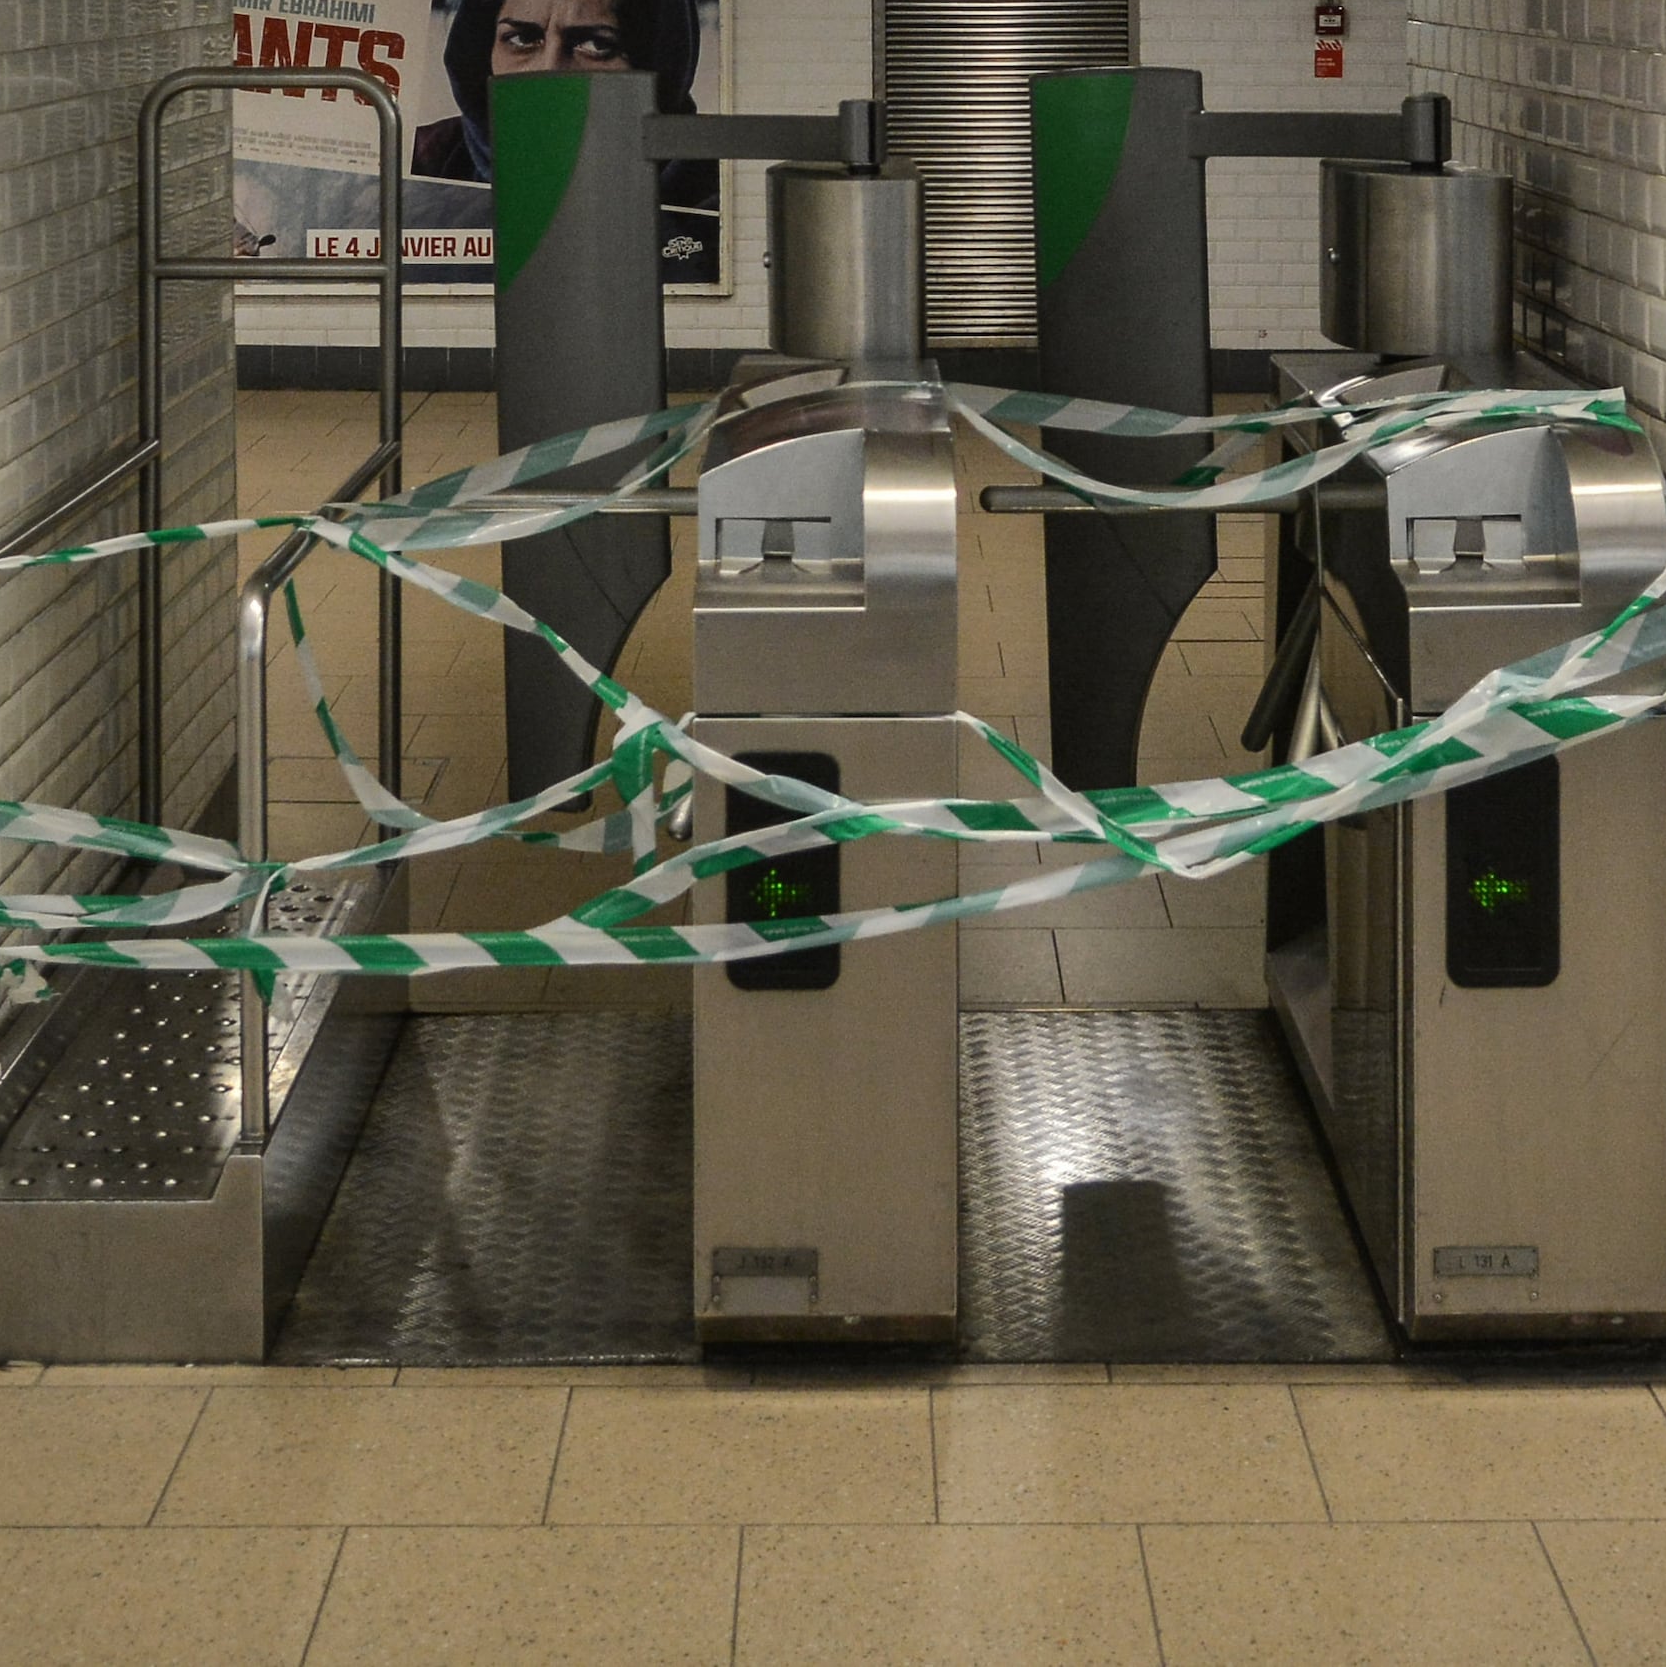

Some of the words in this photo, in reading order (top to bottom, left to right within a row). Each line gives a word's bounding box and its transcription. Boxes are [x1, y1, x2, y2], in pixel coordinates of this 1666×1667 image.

[315, 237, 339, 257] LE
[345, 237, 360, 257] 4
[366, 237, 456, 257] JNVIER
[463, 237, 491, 257] AU
